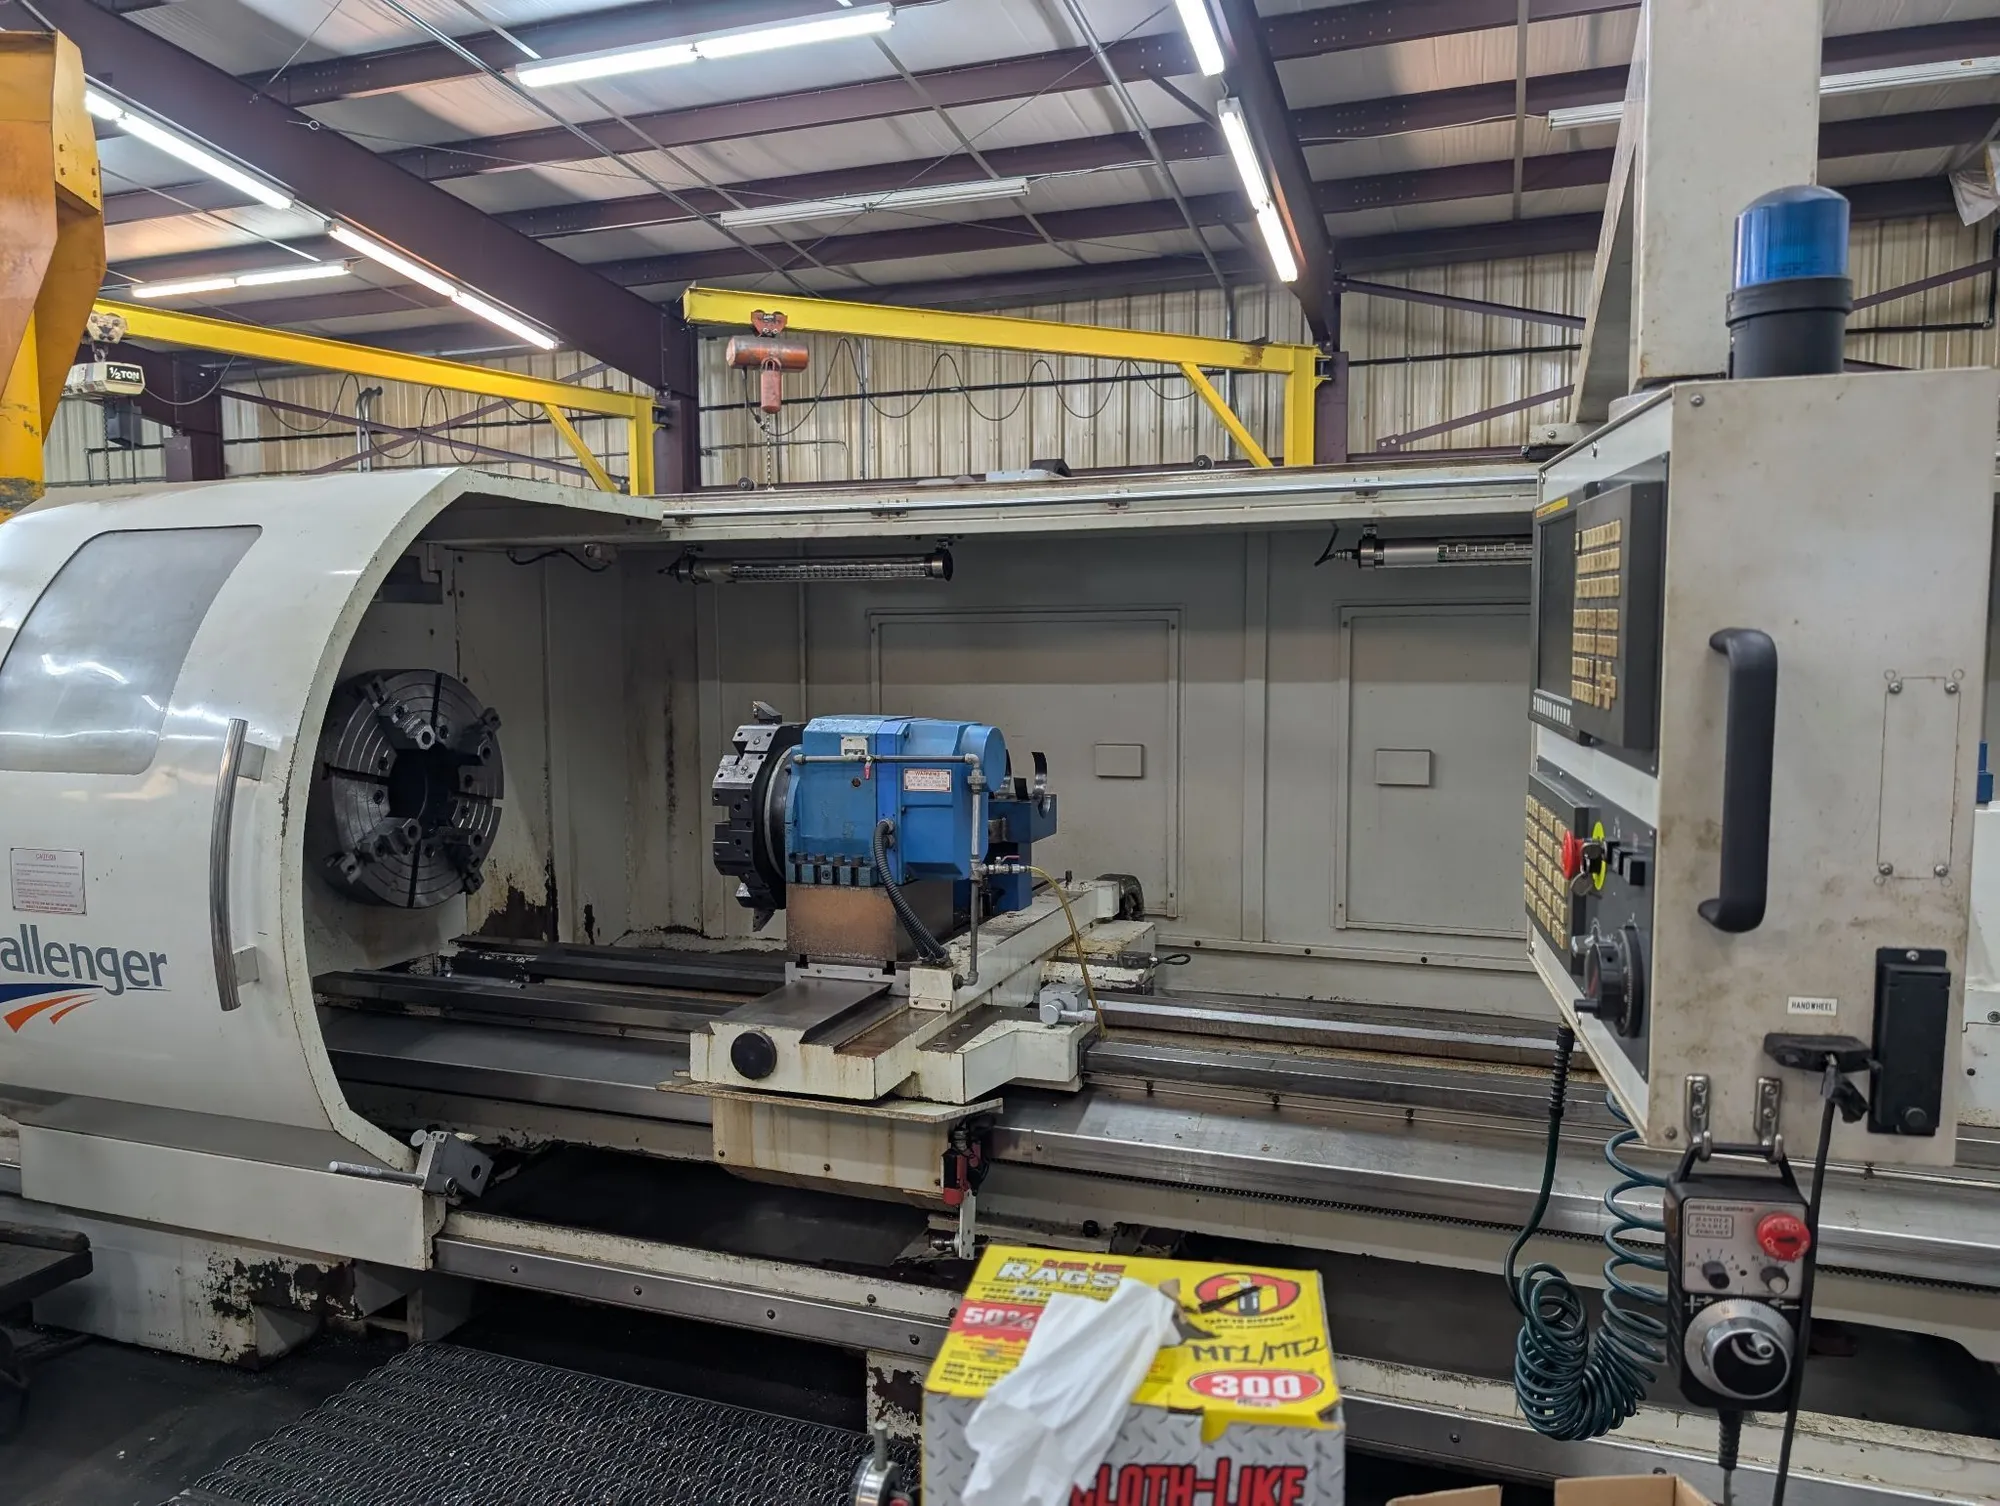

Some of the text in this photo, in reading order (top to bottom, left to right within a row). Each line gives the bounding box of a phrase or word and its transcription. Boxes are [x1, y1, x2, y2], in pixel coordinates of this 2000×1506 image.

[120, 370, 140, 380] TON
[1791, 1001, 1834, 1011] HANDWHEEL
[995, 1262, 1121, 1288] RAGS
[962, 1307, 1036, 1330] 50%
[1210, 1374, 1302, 1399] 300
